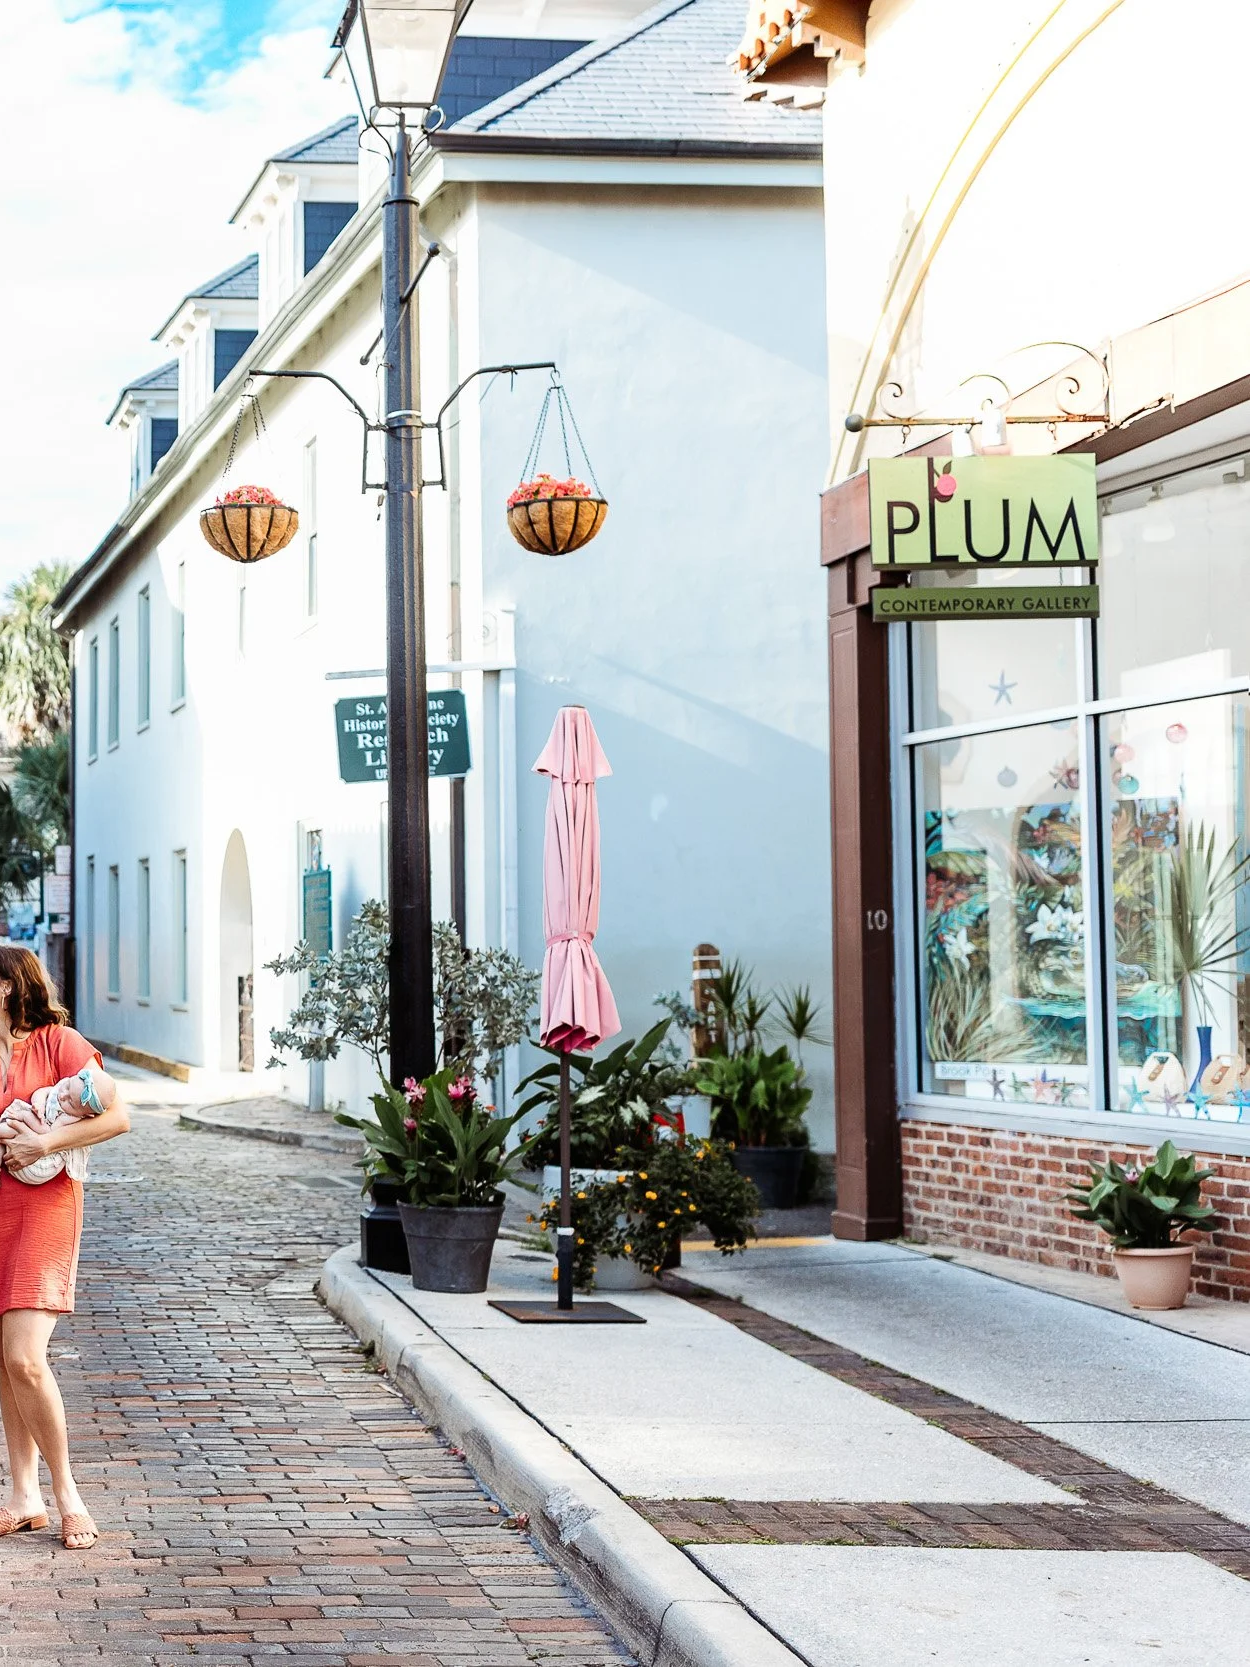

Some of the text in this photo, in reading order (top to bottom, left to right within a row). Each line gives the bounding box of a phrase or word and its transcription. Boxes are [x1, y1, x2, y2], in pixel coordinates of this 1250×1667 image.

[887, 457, 1086, 563] PLUM
[880, 596, 1092, 613] CONTEMPORARY GALLERY
[356, 703, 375, 716] St.
[428, 712, 459, 727] ciety
[867, 909, 888, 931] 10
